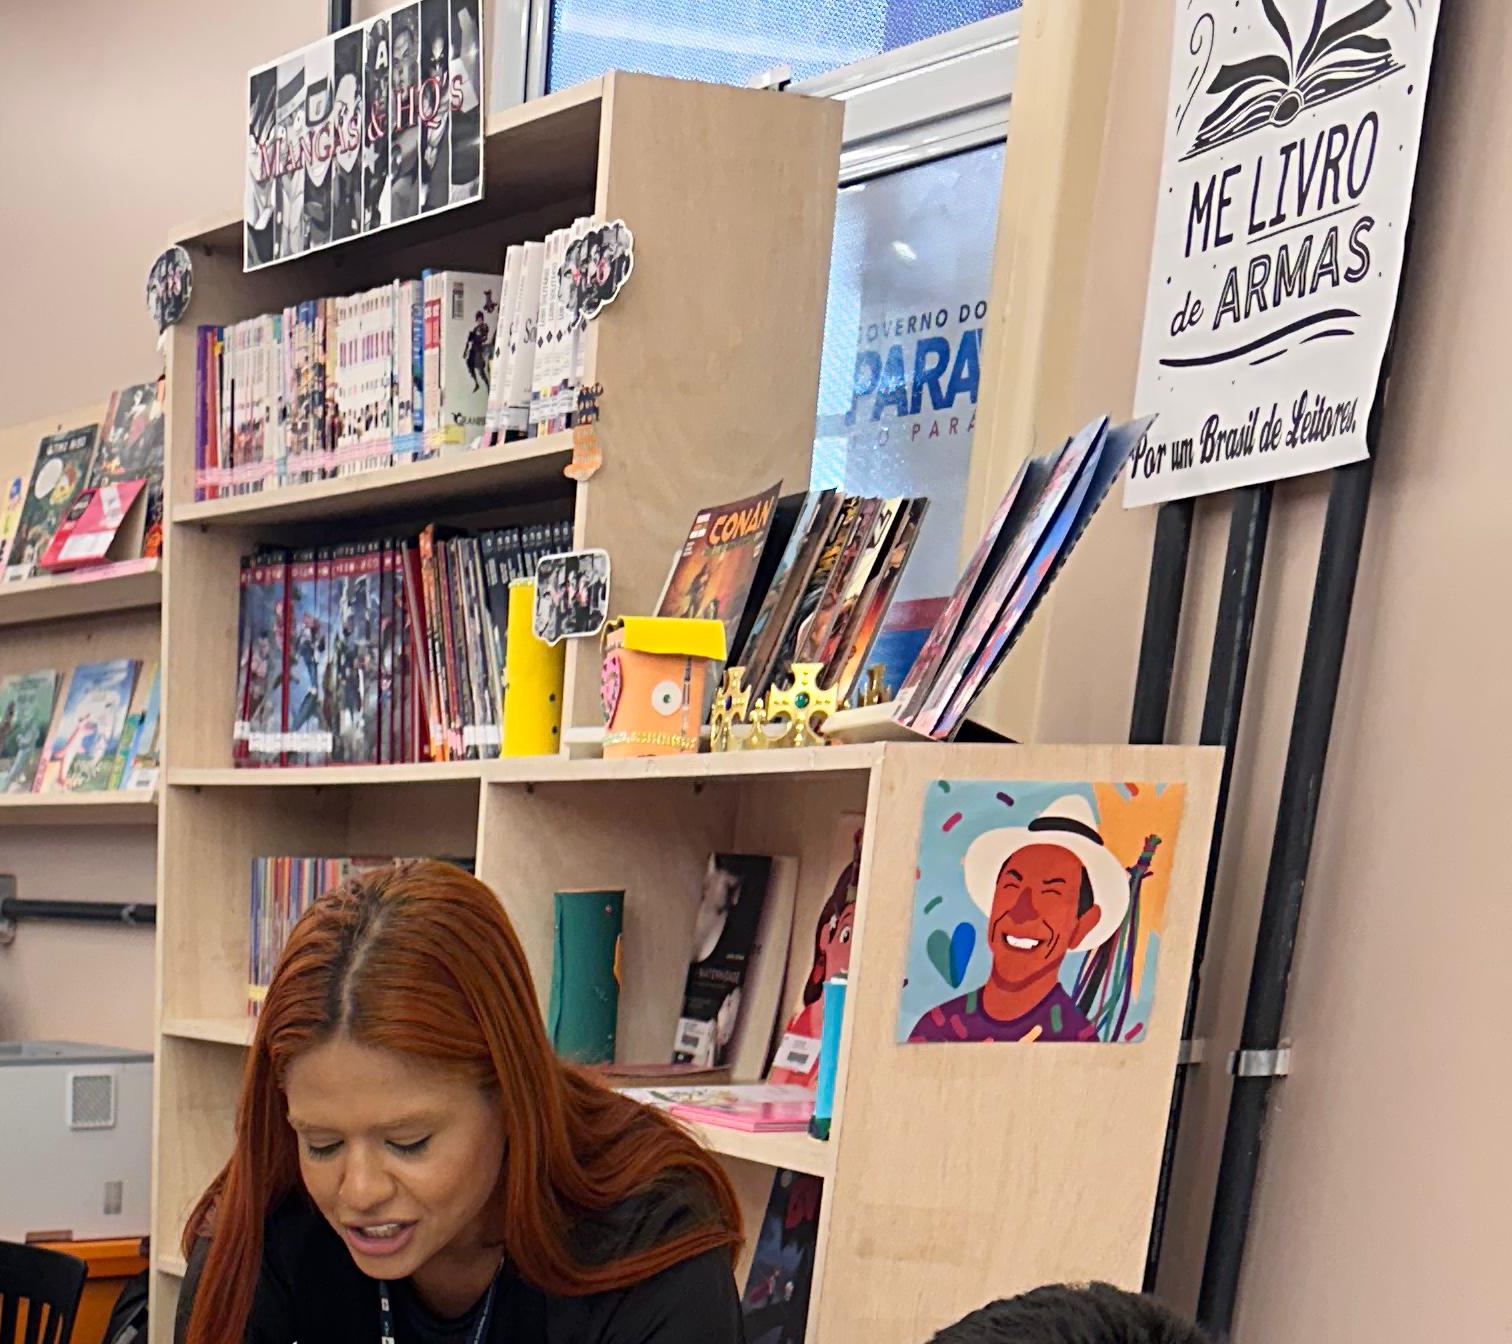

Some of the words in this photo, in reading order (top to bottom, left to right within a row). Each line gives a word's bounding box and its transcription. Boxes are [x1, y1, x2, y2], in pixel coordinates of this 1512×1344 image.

[367, 102, 385, 142] &
[1184, 164, 1242, 258] ME
[1247, 111, 1380, 236] LIVRO
[1170, 290, 1204, 337] de
[1213, 216, 1375, 330] ARMAS
[959, 300, 987, 323] DO
[1129, 431, 1166, 479] Por
[1171, 437, 1194, 472] um
[1200, 407, 1260, 464] Brasil
[1260, 403, 1283, 453] de
[708, 496, 774, 545] CONAN
